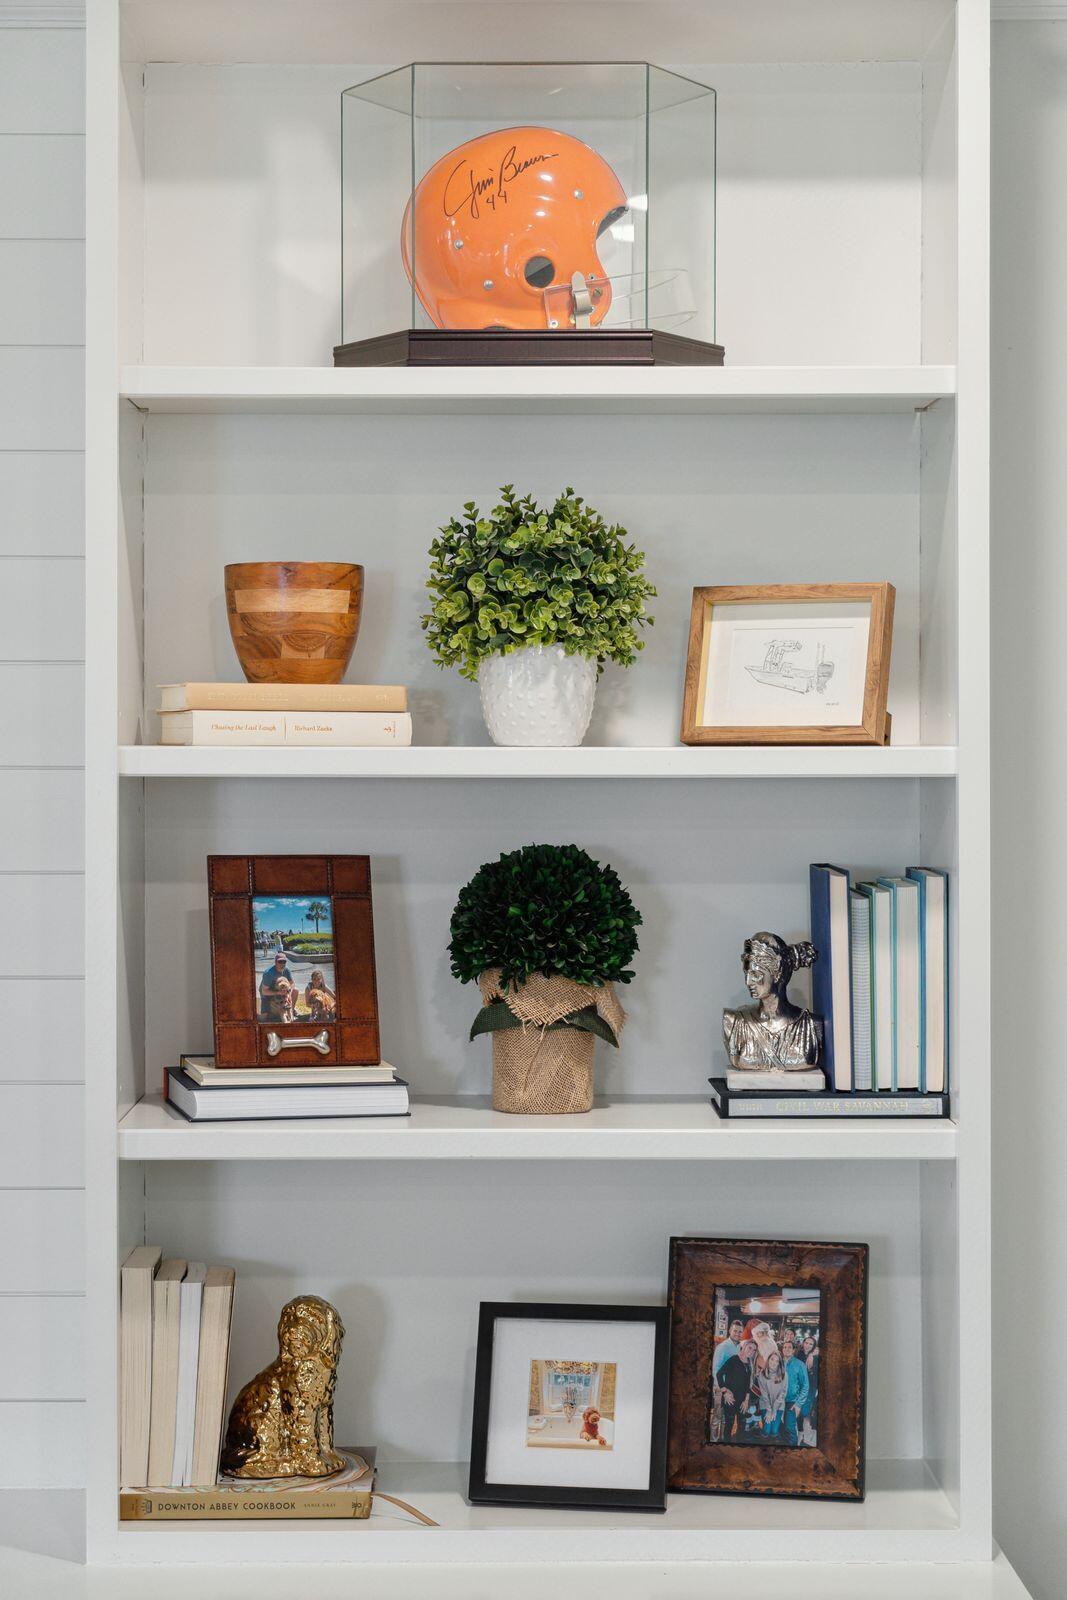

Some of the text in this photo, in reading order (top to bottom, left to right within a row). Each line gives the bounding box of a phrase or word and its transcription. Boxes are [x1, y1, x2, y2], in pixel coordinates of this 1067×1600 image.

[444, 159, 494, 219] Jim
[486, 190, 507, 210] 44
[157, 1502, 297, 1511] DOWNTON ABBEY COOKBOOK
